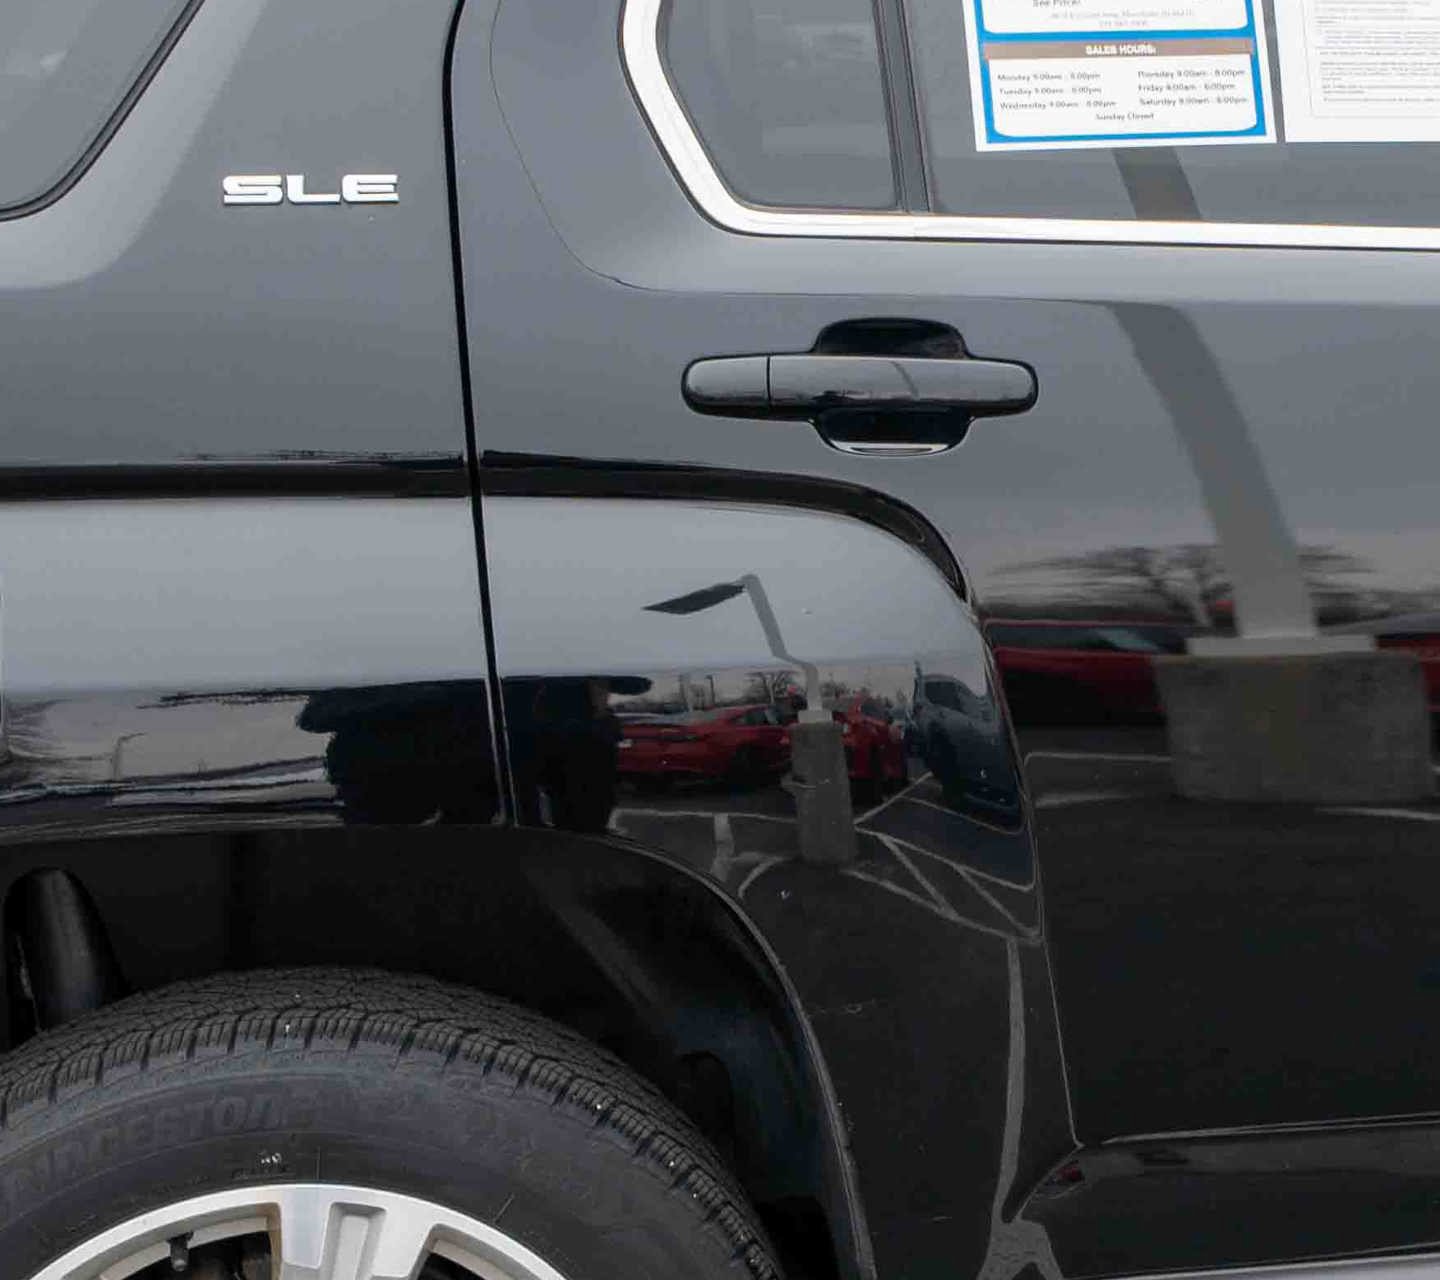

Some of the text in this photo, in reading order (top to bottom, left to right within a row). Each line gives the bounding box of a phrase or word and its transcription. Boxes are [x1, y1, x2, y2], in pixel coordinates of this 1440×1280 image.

[1085, 44, 1157, 56] SALES HOURS:
[222, 174, 400, 205] SLE
